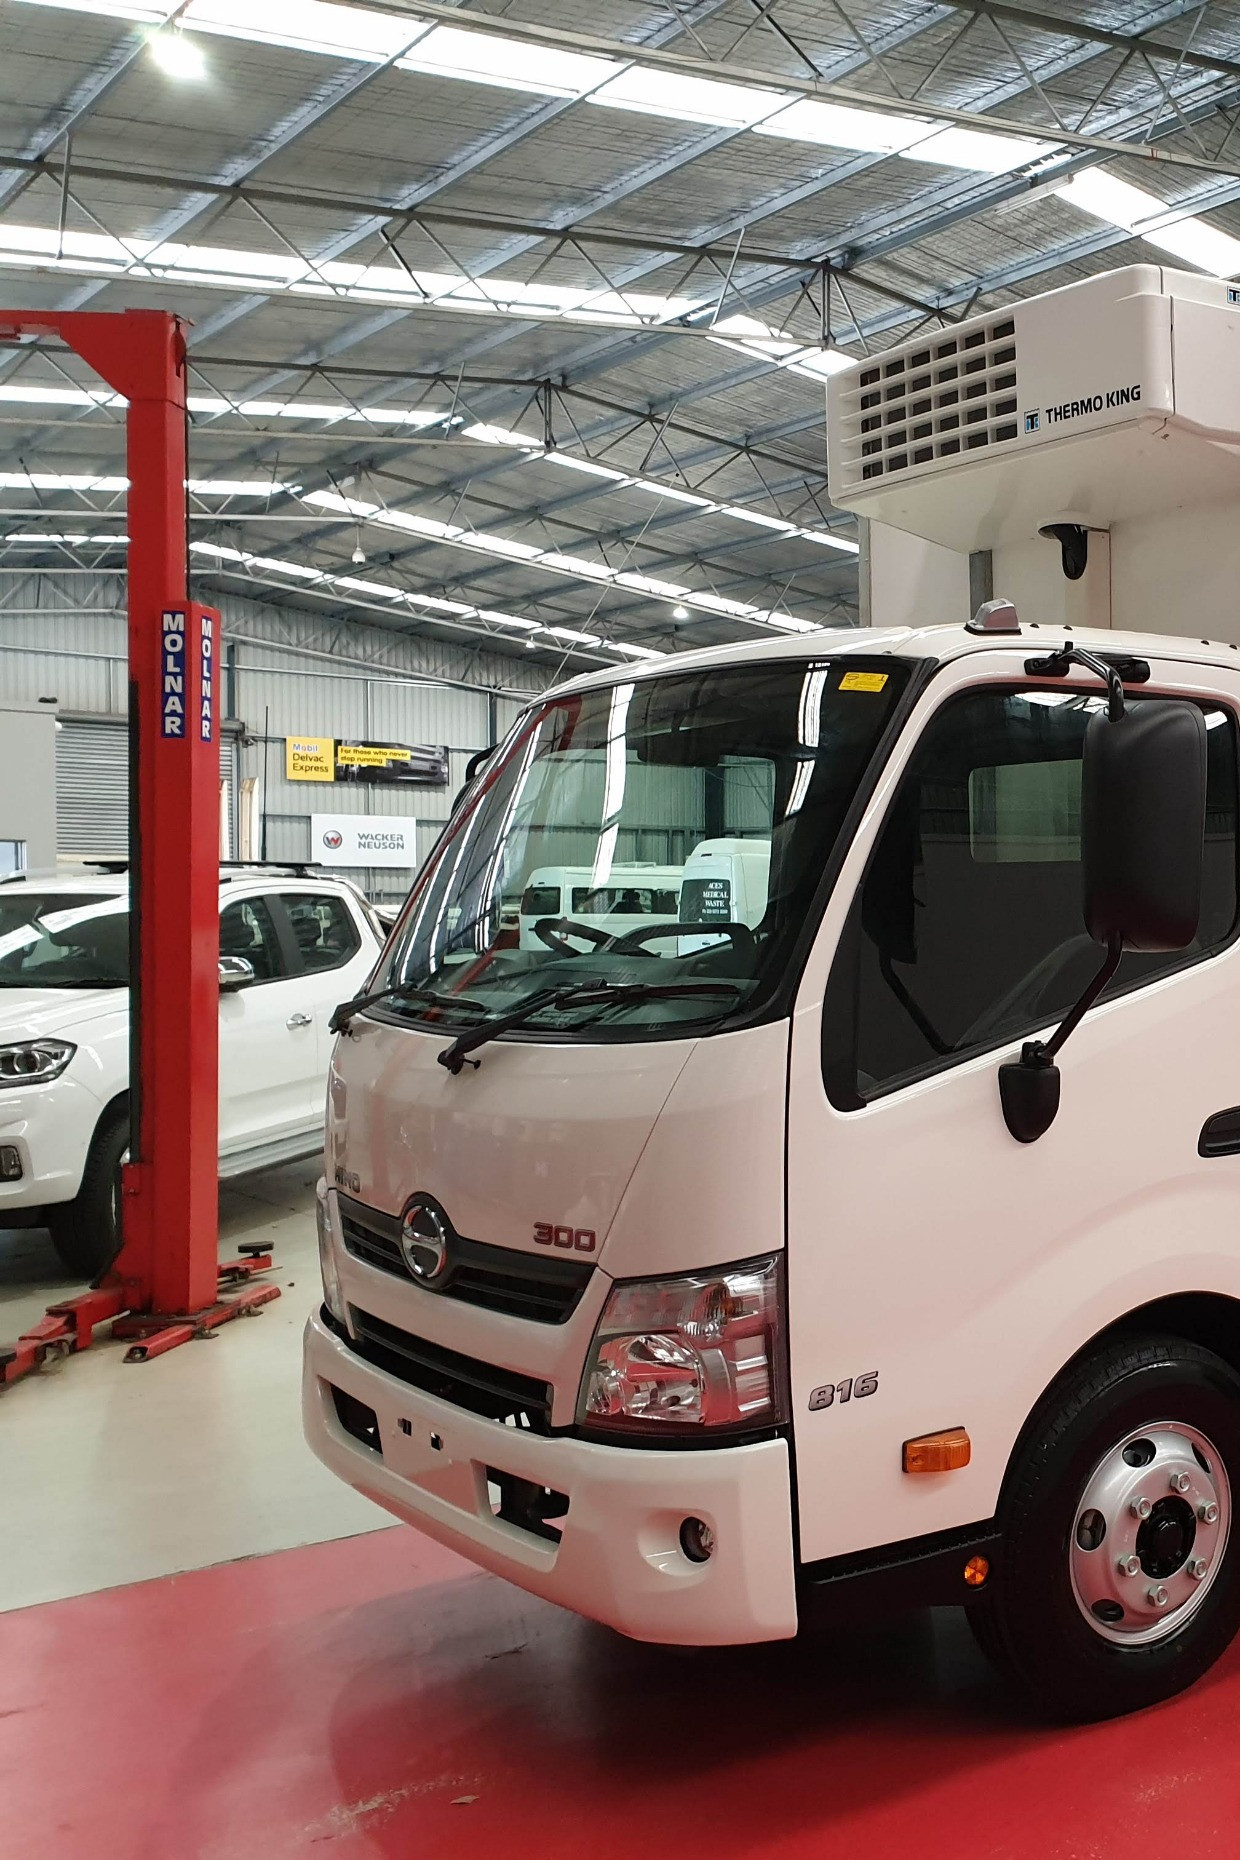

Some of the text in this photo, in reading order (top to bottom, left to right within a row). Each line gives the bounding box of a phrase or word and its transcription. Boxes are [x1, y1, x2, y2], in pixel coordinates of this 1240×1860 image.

[1045, 395, 1103, 424] THERMO
[1106, 384, 1141, 409] KING
[162, 613, 185, 735] MOLNAR
[201, 618, 212, 738] MOLNAR
[292, 743, 318, 752] Mobil
[292, 753, 324, 763] Delvac
[357, 757, 383, 765] running
[292, 763, 329, 773] Express
[357, 833, 404, 842] WACKER
[358, 841, 405, 850] NEUSON
[533, 1221, 596, 1252] 300
[808, 1370, 879, 1412] 816
